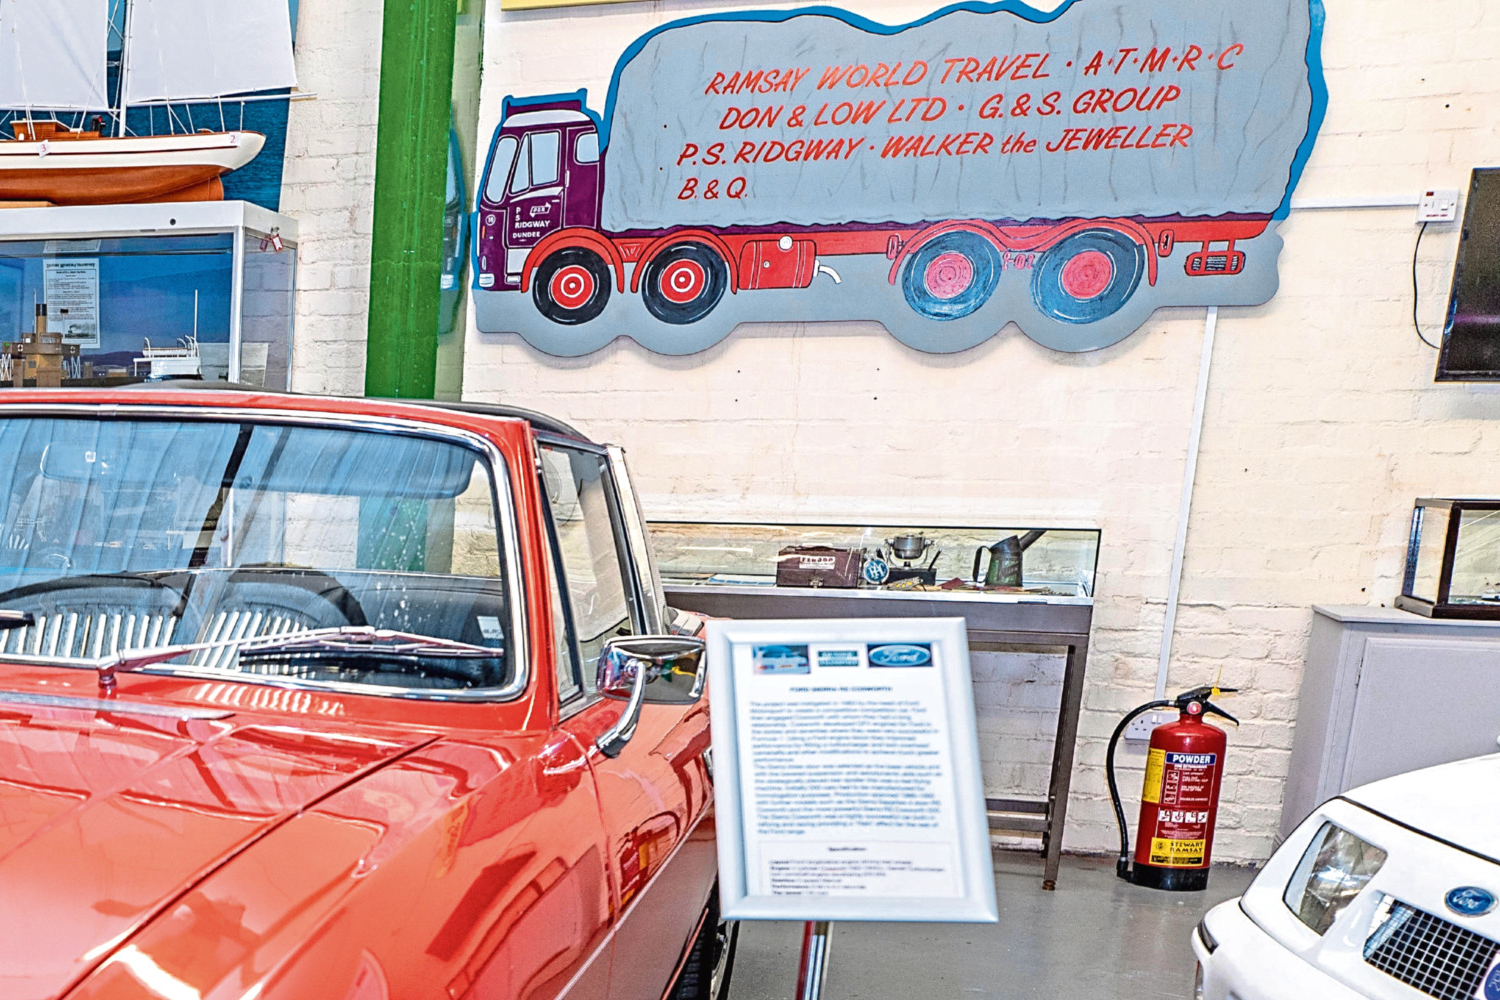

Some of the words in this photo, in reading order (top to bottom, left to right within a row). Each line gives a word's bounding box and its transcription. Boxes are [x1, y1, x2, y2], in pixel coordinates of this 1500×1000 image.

[705, 67, 811, 95] RAMSAY
[816, 58, 928, 91] WORLD
[940, 52, 1050, 85] TRAVEL
[719, 104, 784, 130] DON
[786, 104, 807, 129] &
[813, 100, 887, 127] LOW
[887, 97, 947, 124] LTD
[1072, 84, 1181, 114] GROUP
[733, 137, 866, 164] RIDGWAY
[880, 131, 995, 159] WALKER
[999, 131, 1038, 154] the
[1044, 123, 1193, 152] JEWELLER
[514, 220, 551, 229] RIDGWAY
[512, 231, 541, 239] DUNDEE
[1173, 754, 1211, 764] POWDER
[1452, 889, 1482, 909] Ford
